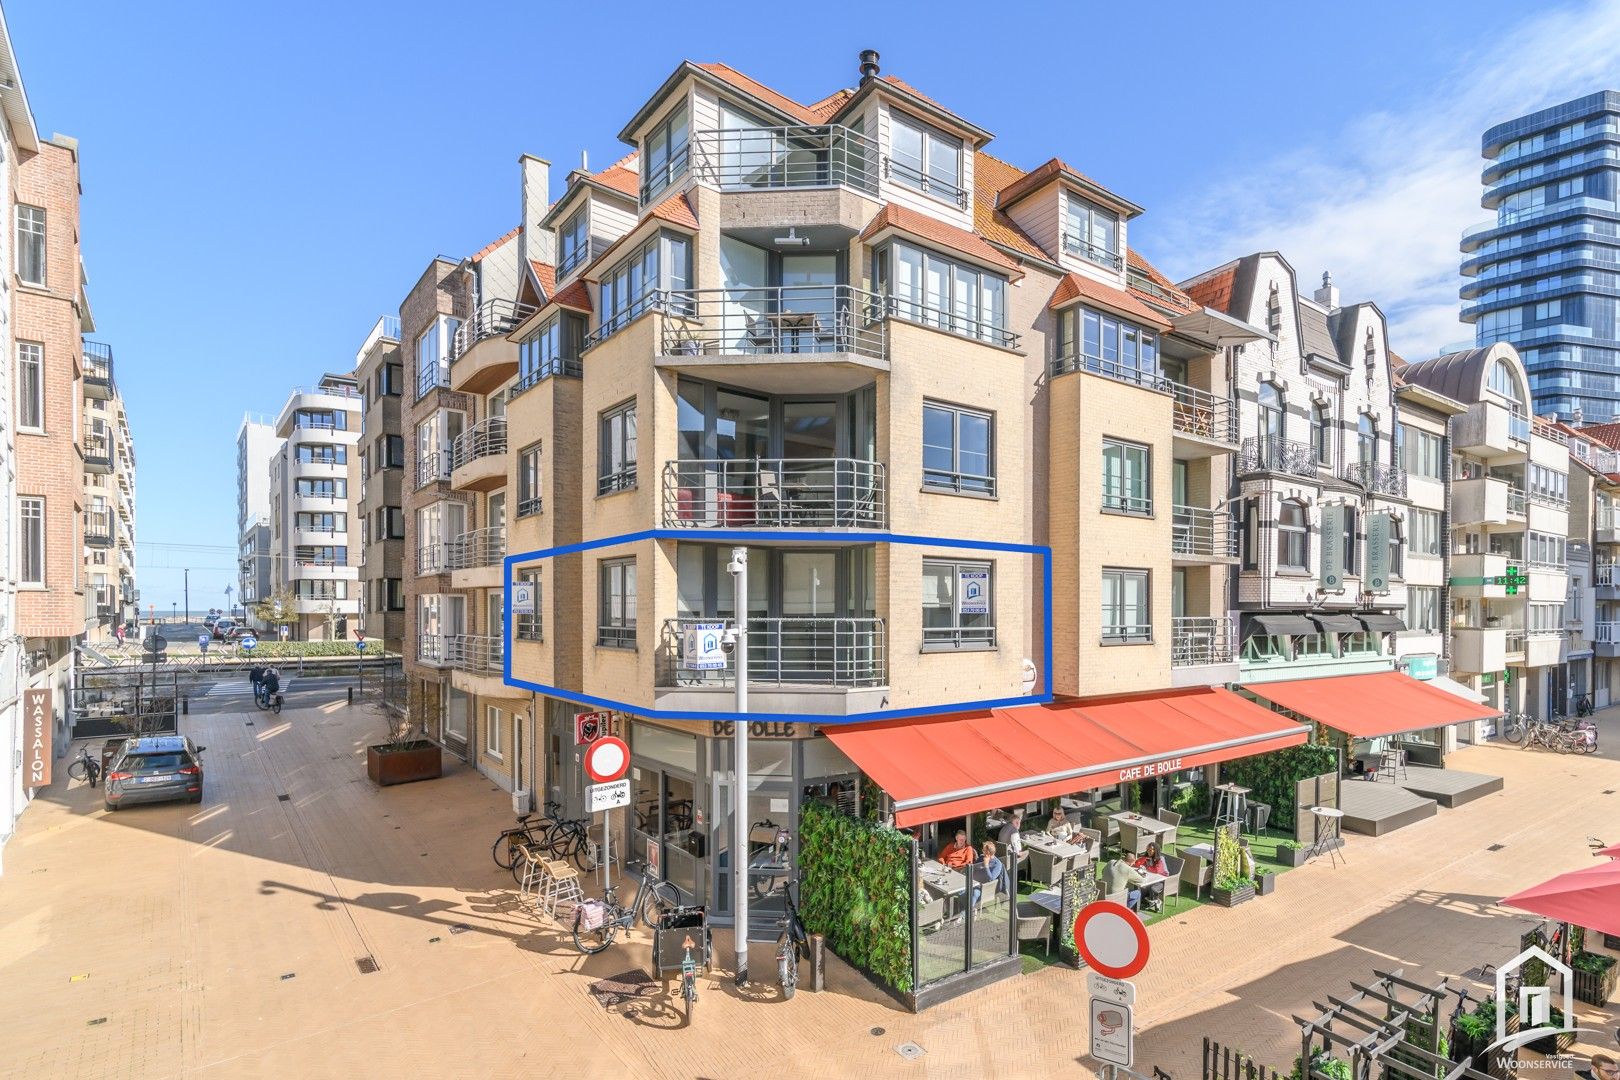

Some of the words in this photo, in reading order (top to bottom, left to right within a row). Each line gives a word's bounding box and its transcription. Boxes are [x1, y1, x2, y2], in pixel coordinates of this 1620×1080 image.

[1326, 512, 1334, 557] BRASSERIE
[1371, 519, 1380, 561] BRASSERIE
[1497, 576, 1526, 584] 11:42
[31, 693, 45, 782] WASSALON
[714, 720, 735, 736] DE
[747, 720, 795, 737] OLLE
[1120, 767, 1141, 781] CAFE
[1144, 764, 1155, 776] DE
[1157, 758, 1182, 773] BOLLE
[589, 782, 627, 794] UITGEZONDERD
